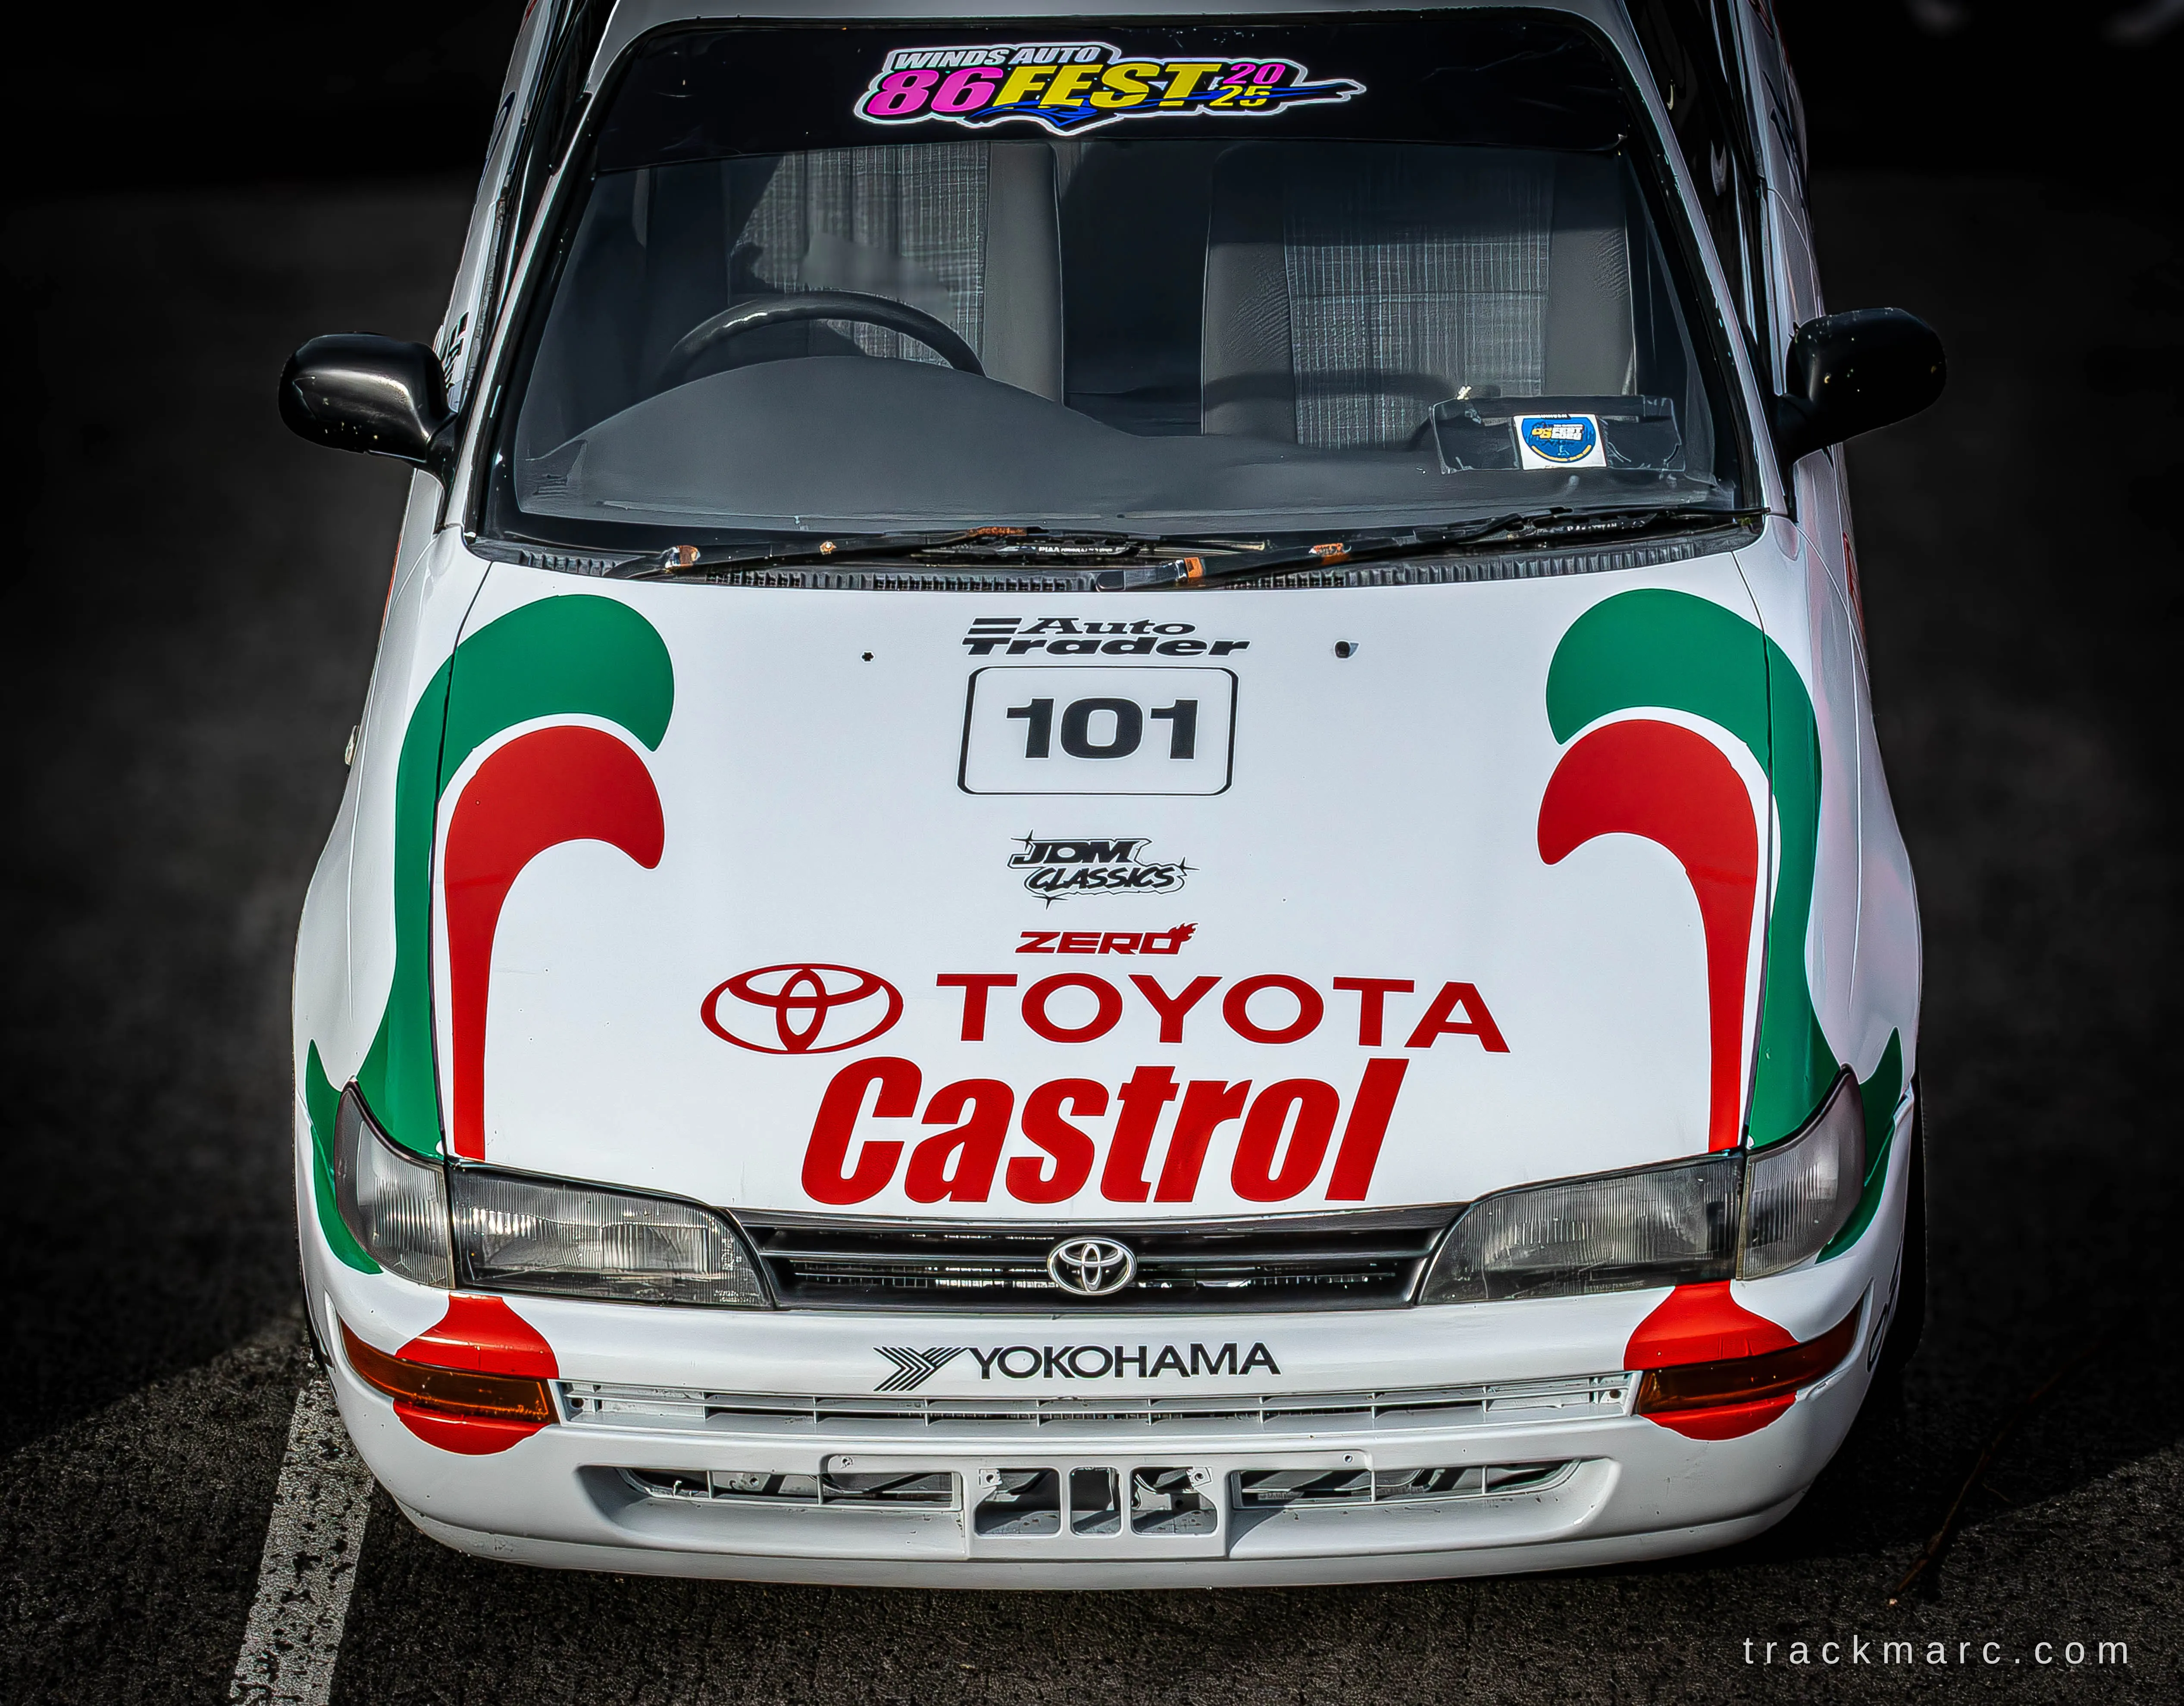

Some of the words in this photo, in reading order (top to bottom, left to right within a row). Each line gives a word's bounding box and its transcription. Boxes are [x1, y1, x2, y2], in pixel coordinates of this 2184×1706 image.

[895, 50, 1008, 69] WINDS
[1008, 47, 1101, 65] AUTO
[1223, 63, 1286, 84] 20
[1017, 617, 1196, 635] Auto
[962, 636, 1251, 656] Trader
[1006, 697, 1198, 759] 101
[1011, 841, 1140, 864] JDM
[1028, 867, 1175, 892] CLASSICS
[1015, 923, 1196, 955] ZERO
[936, 972, 1510, 1053] TOYOTA
[801, 1056, 1410, 1203] Castrol
[968, 1342, 1281, 1379] YOKOHAMA
